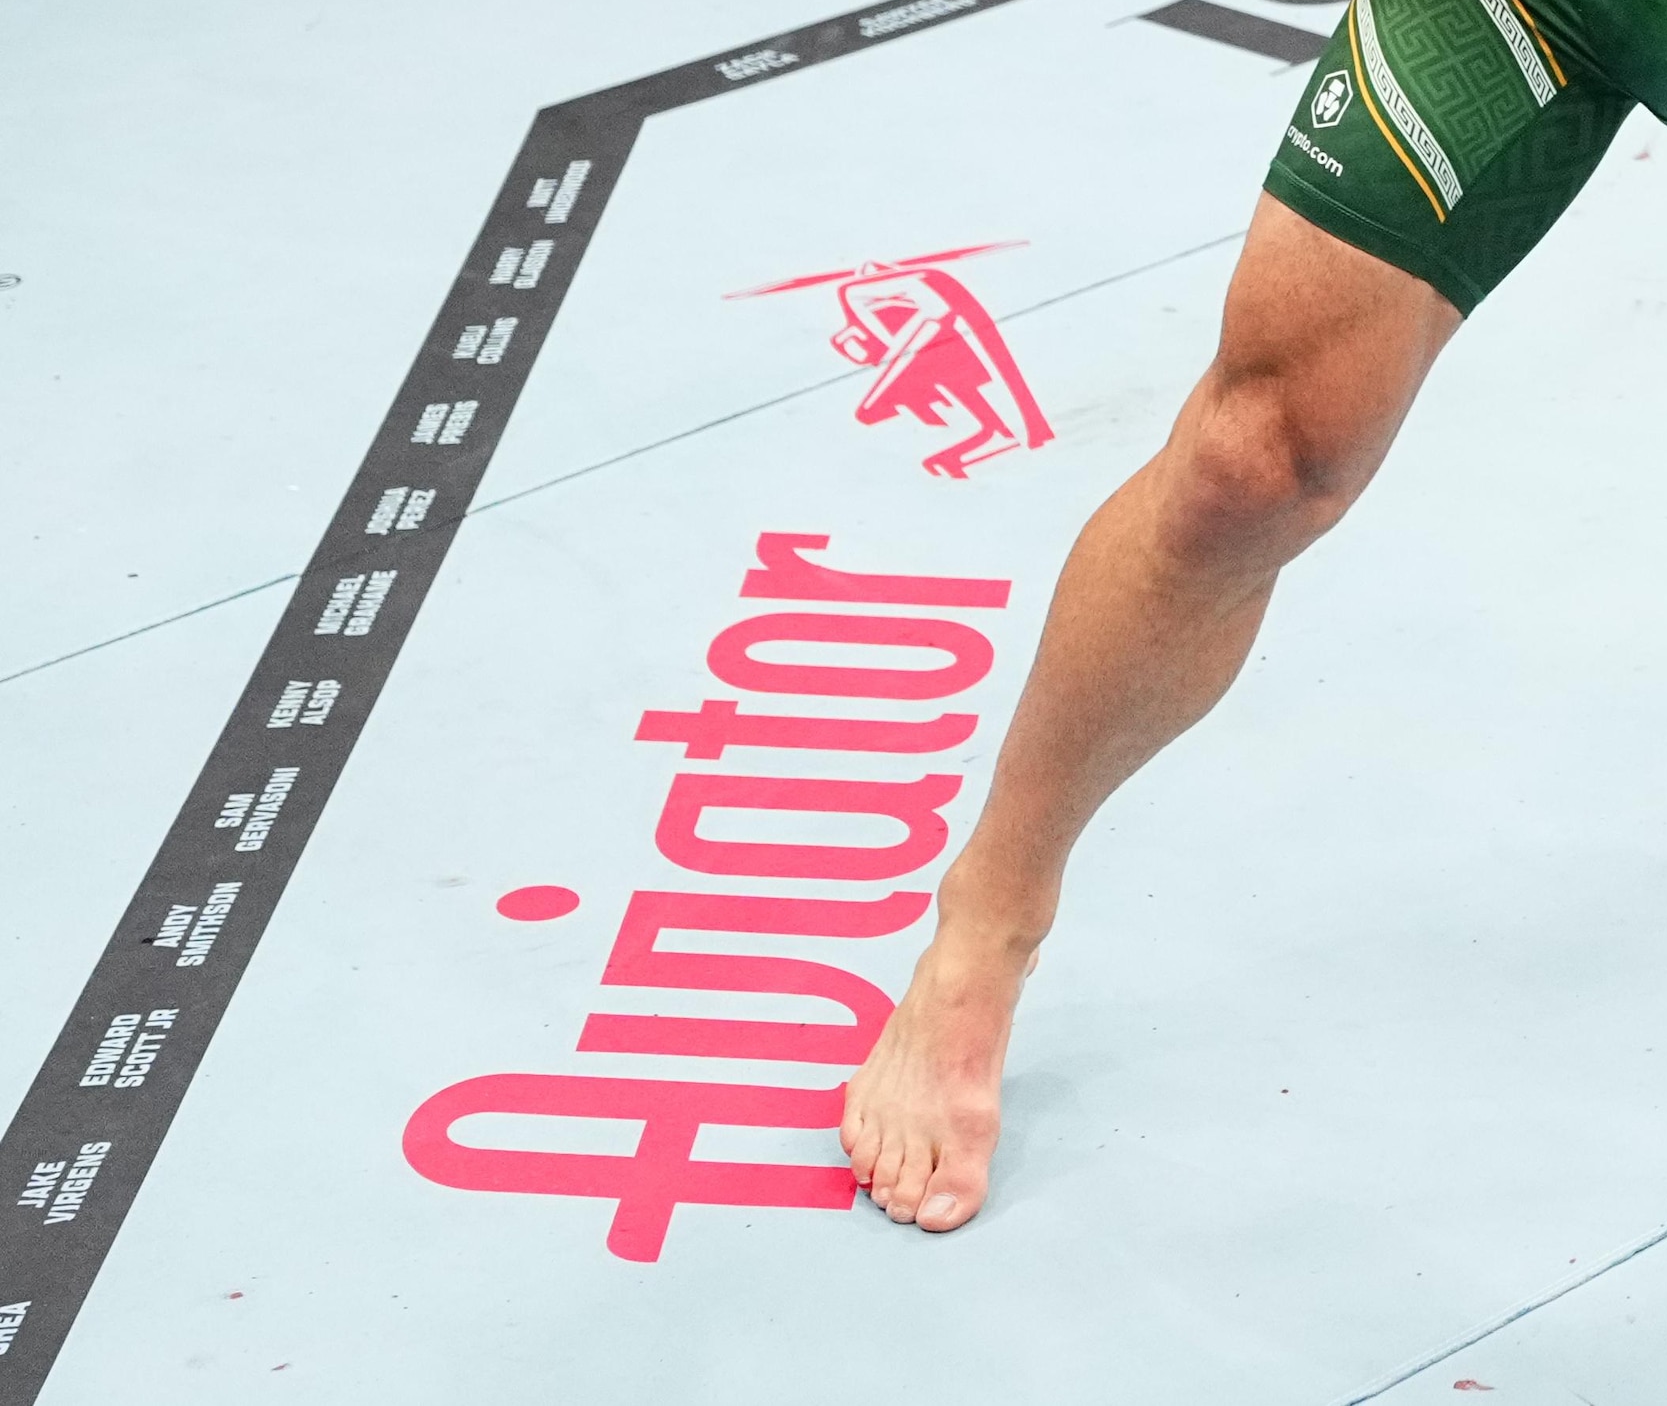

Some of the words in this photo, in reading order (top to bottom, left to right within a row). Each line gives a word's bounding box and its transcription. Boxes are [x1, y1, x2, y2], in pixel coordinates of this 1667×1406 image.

[1286, 124, 1344, 178] crypto.com
[314, 574, 365, 634] MICHAEL
[344, 570, 398, 636] GRAHAME
[267, 681, 312, 728] KENNY
[300, 680, 341, 725] ALSOP
[215, 794, 255, 828] SAM
[235, 767, 300, 851] GERVASONI
[153, 905, 198, 947] ANDY
[176, 882, 242, 966] SMITHSON
[401, 530, 1013, 1263] Aviator
[79, 1014, 141, 1086] EDWARD
[114, 1032, 167, 1088] SCOTT
[145, 1008, 180, 1029] JR
[17, 1161, 66, 1208] JAKE
[44, 1142, 112, 1225] VIRGENS
